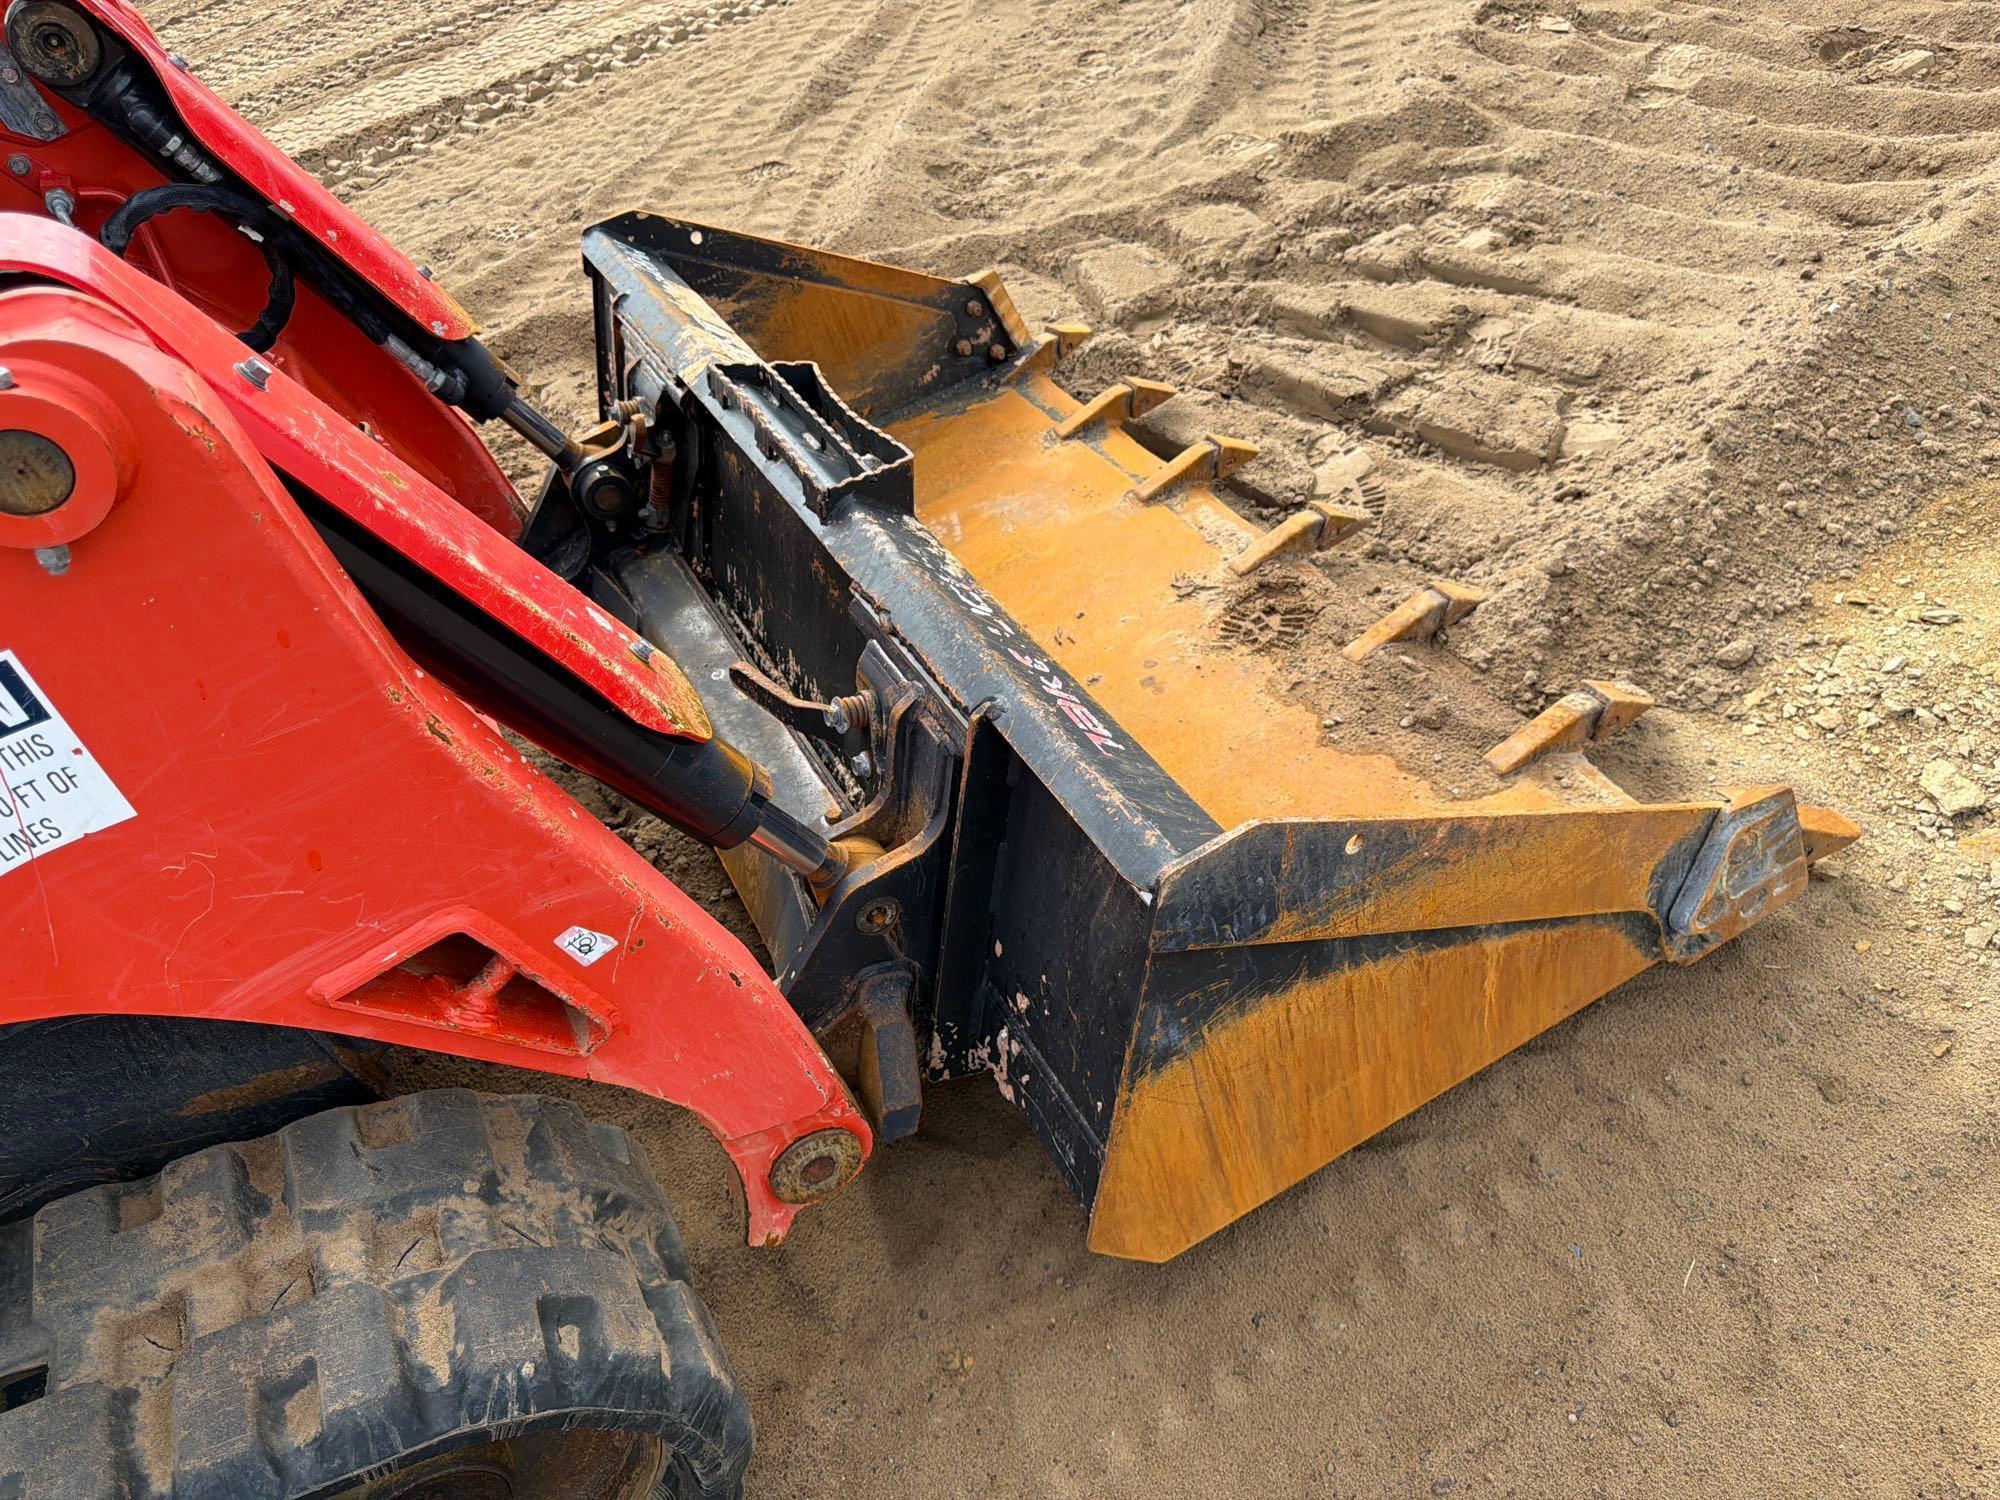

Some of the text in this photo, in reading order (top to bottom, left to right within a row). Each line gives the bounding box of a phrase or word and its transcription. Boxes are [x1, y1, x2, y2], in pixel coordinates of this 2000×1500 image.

[0, 733, 55, 771] THIS
[12, 780, 46, 808] FT
[47, 766, 79, 794] OF
[0, 817, 62, 862] LINES
